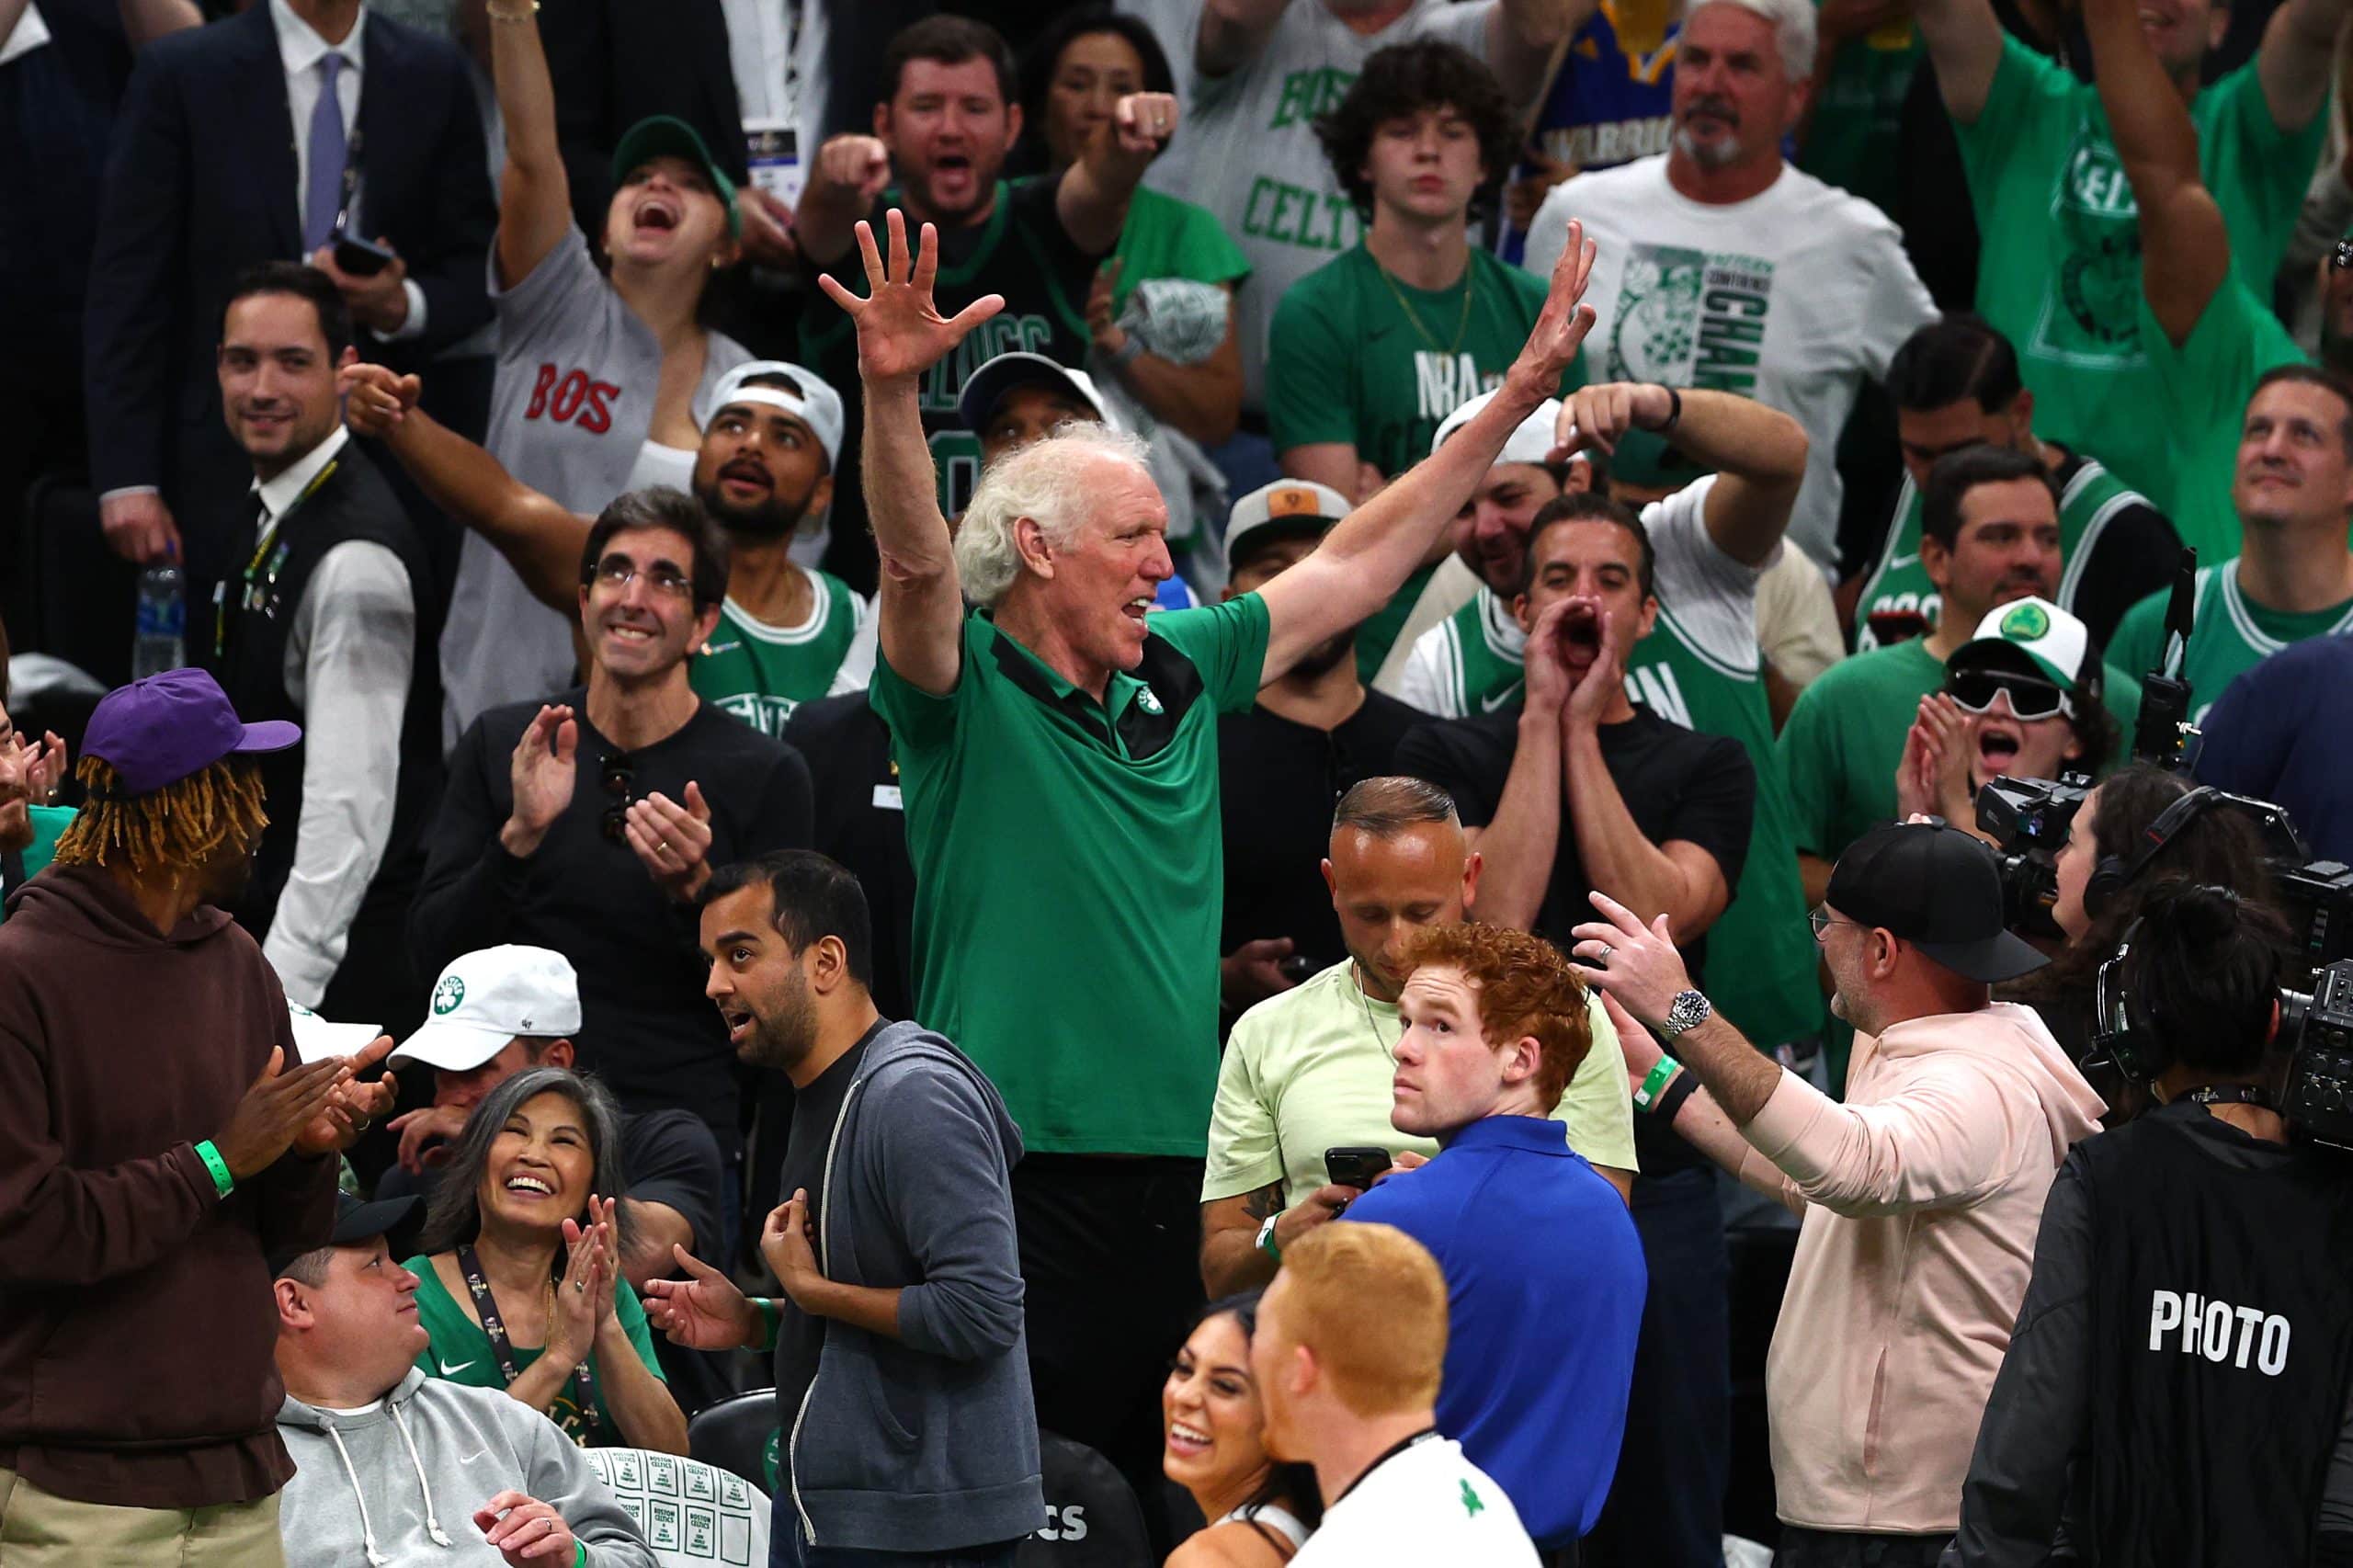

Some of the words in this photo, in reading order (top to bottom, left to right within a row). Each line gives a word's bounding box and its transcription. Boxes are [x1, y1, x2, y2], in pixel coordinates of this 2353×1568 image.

[1414, 350, 1480, 422] NBA
[523, 362, 620, 435] BOS
[2149, 1290, 2291, 1376] PHOTO
[654, 1507, 676, 1517] BOSTON
[690, 1512, 711, 1523] BOSTON
[654, 1515, 675, 1524] CELTICS
[691, 1520, 710, 1530] CELTICS
